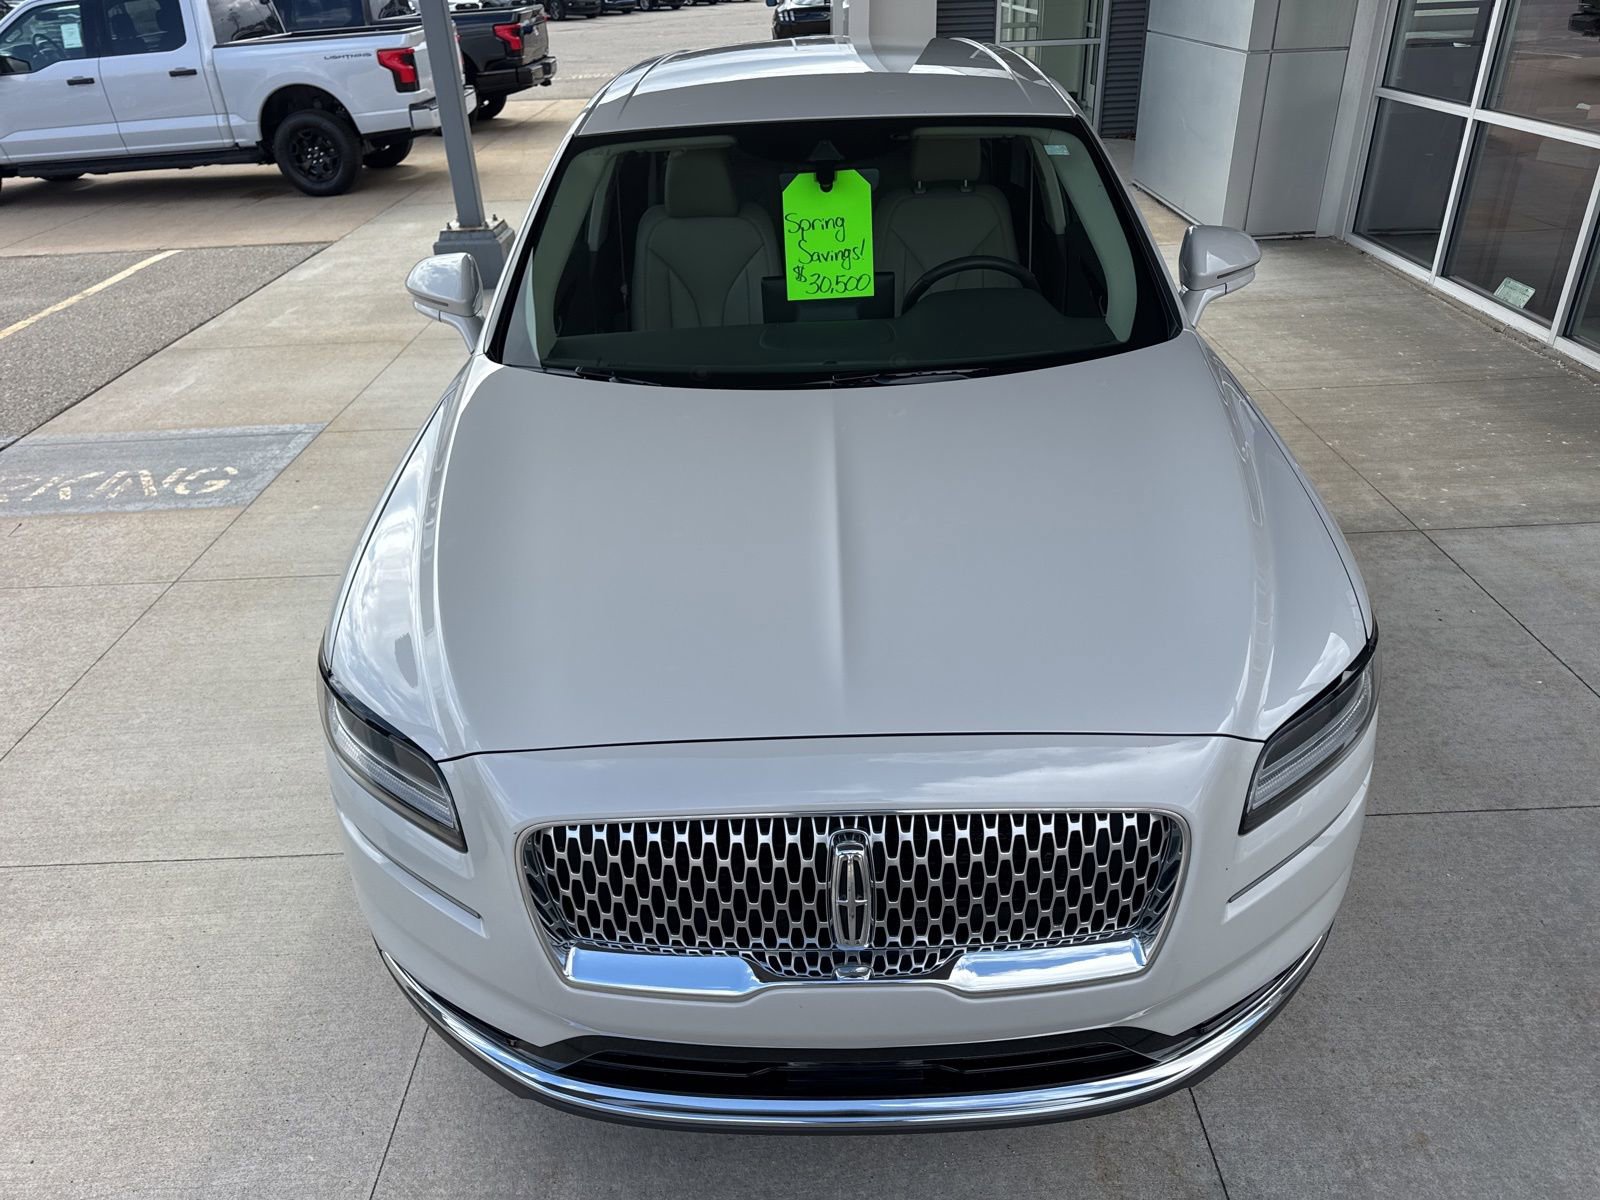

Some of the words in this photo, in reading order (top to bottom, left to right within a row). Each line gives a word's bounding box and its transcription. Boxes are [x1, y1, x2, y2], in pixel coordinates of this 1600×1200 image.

[323, 52, 372, 60] LIGHTNING
[784, 212, 846, 243] Spring
[797, 238, 866, 271] Savings!
[792, 264, 872, 295] $30,500
